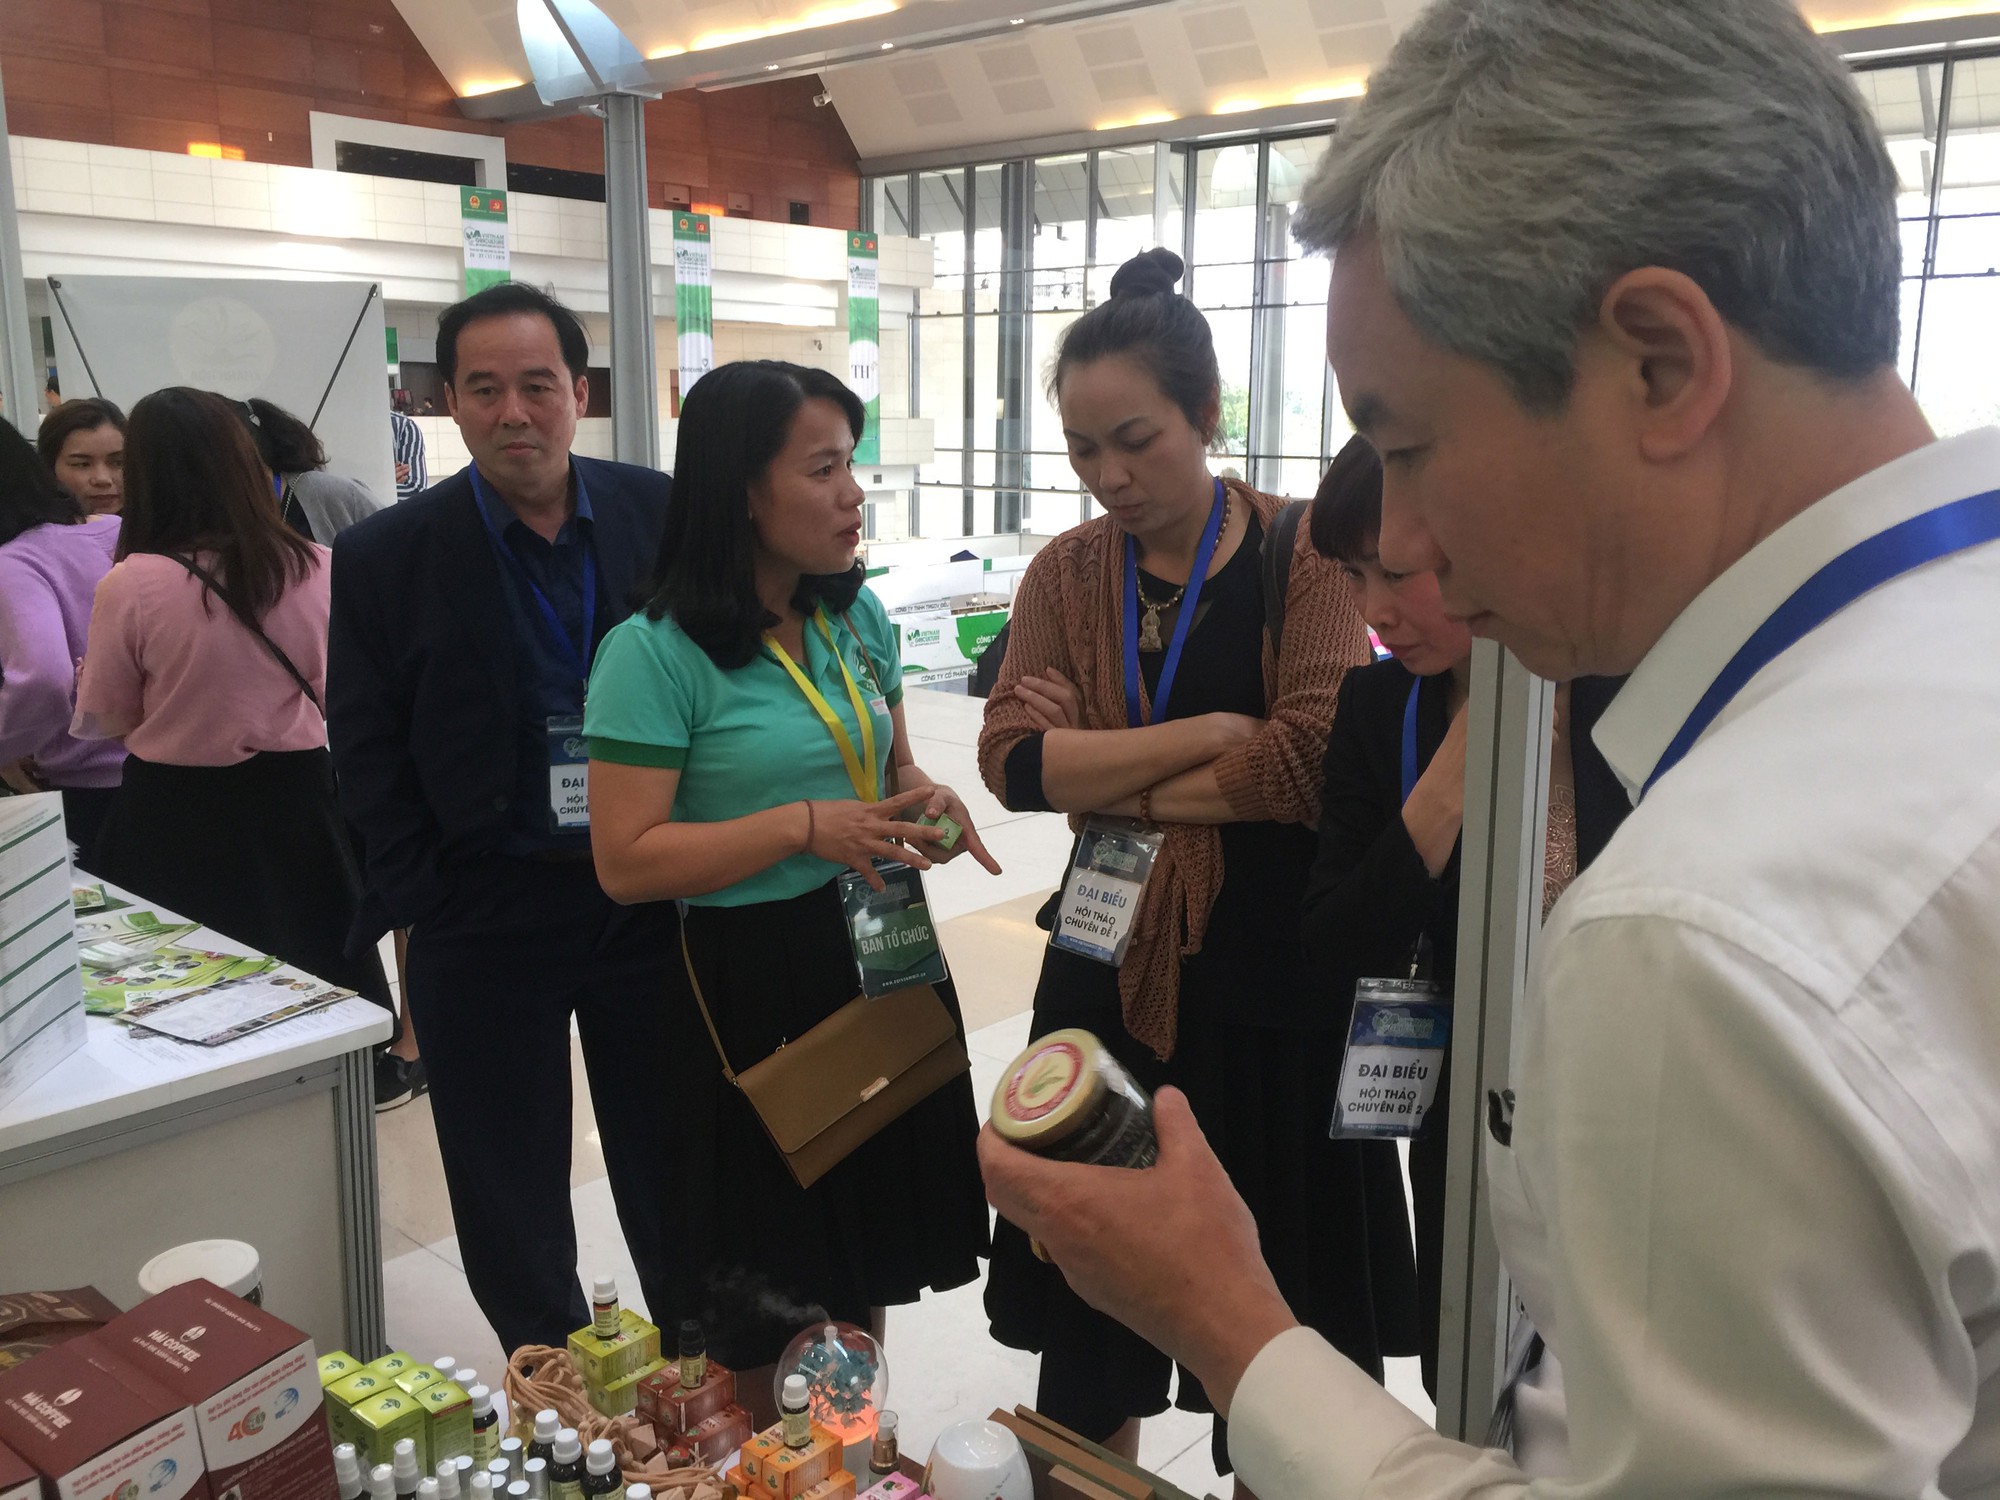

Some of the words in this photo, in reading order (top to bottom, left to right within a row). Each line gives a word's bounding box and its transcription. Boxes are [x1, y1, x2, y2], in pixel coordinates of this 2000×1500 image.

[851, 364, 869, 379] TH
[976, 635, 991, 645] CÔNG
[921, 674, 936, 682] CÔNG
[561, 777, 584, 790] ĐẠI
[566, 794, 584, 804] HỘI
[1077, 884, 1099, 903] ĐẠI
[1100, 889, 1128, 909] BIỂU
[1074, 905, 1092, 919] HỘI
[1064, 915, 1099, 935] CHUYÊN
[1100, 923, 1112, 938] ĐỀ
[861, 937, 884, 955] BAN
[885, 926, 899, 949] TỔ
[900, 925, 930, 945] CHỨC
[1358, 1064, 1387, 1082] ĐẠI
[1392, 1059, 1428, 1080] BIỂU
[1359, 1087, 1382, 1101] HỘI
[1348, 1102, 1394, 1113] CHUYÊN
[1397, 1099, 1413, 1115] ĐỀ
[1415, 1105, 1423, 1116] 2
[162, 1338, 201, 1362] COFFEE
[34, 1401, 72, 1429] COFFEE
